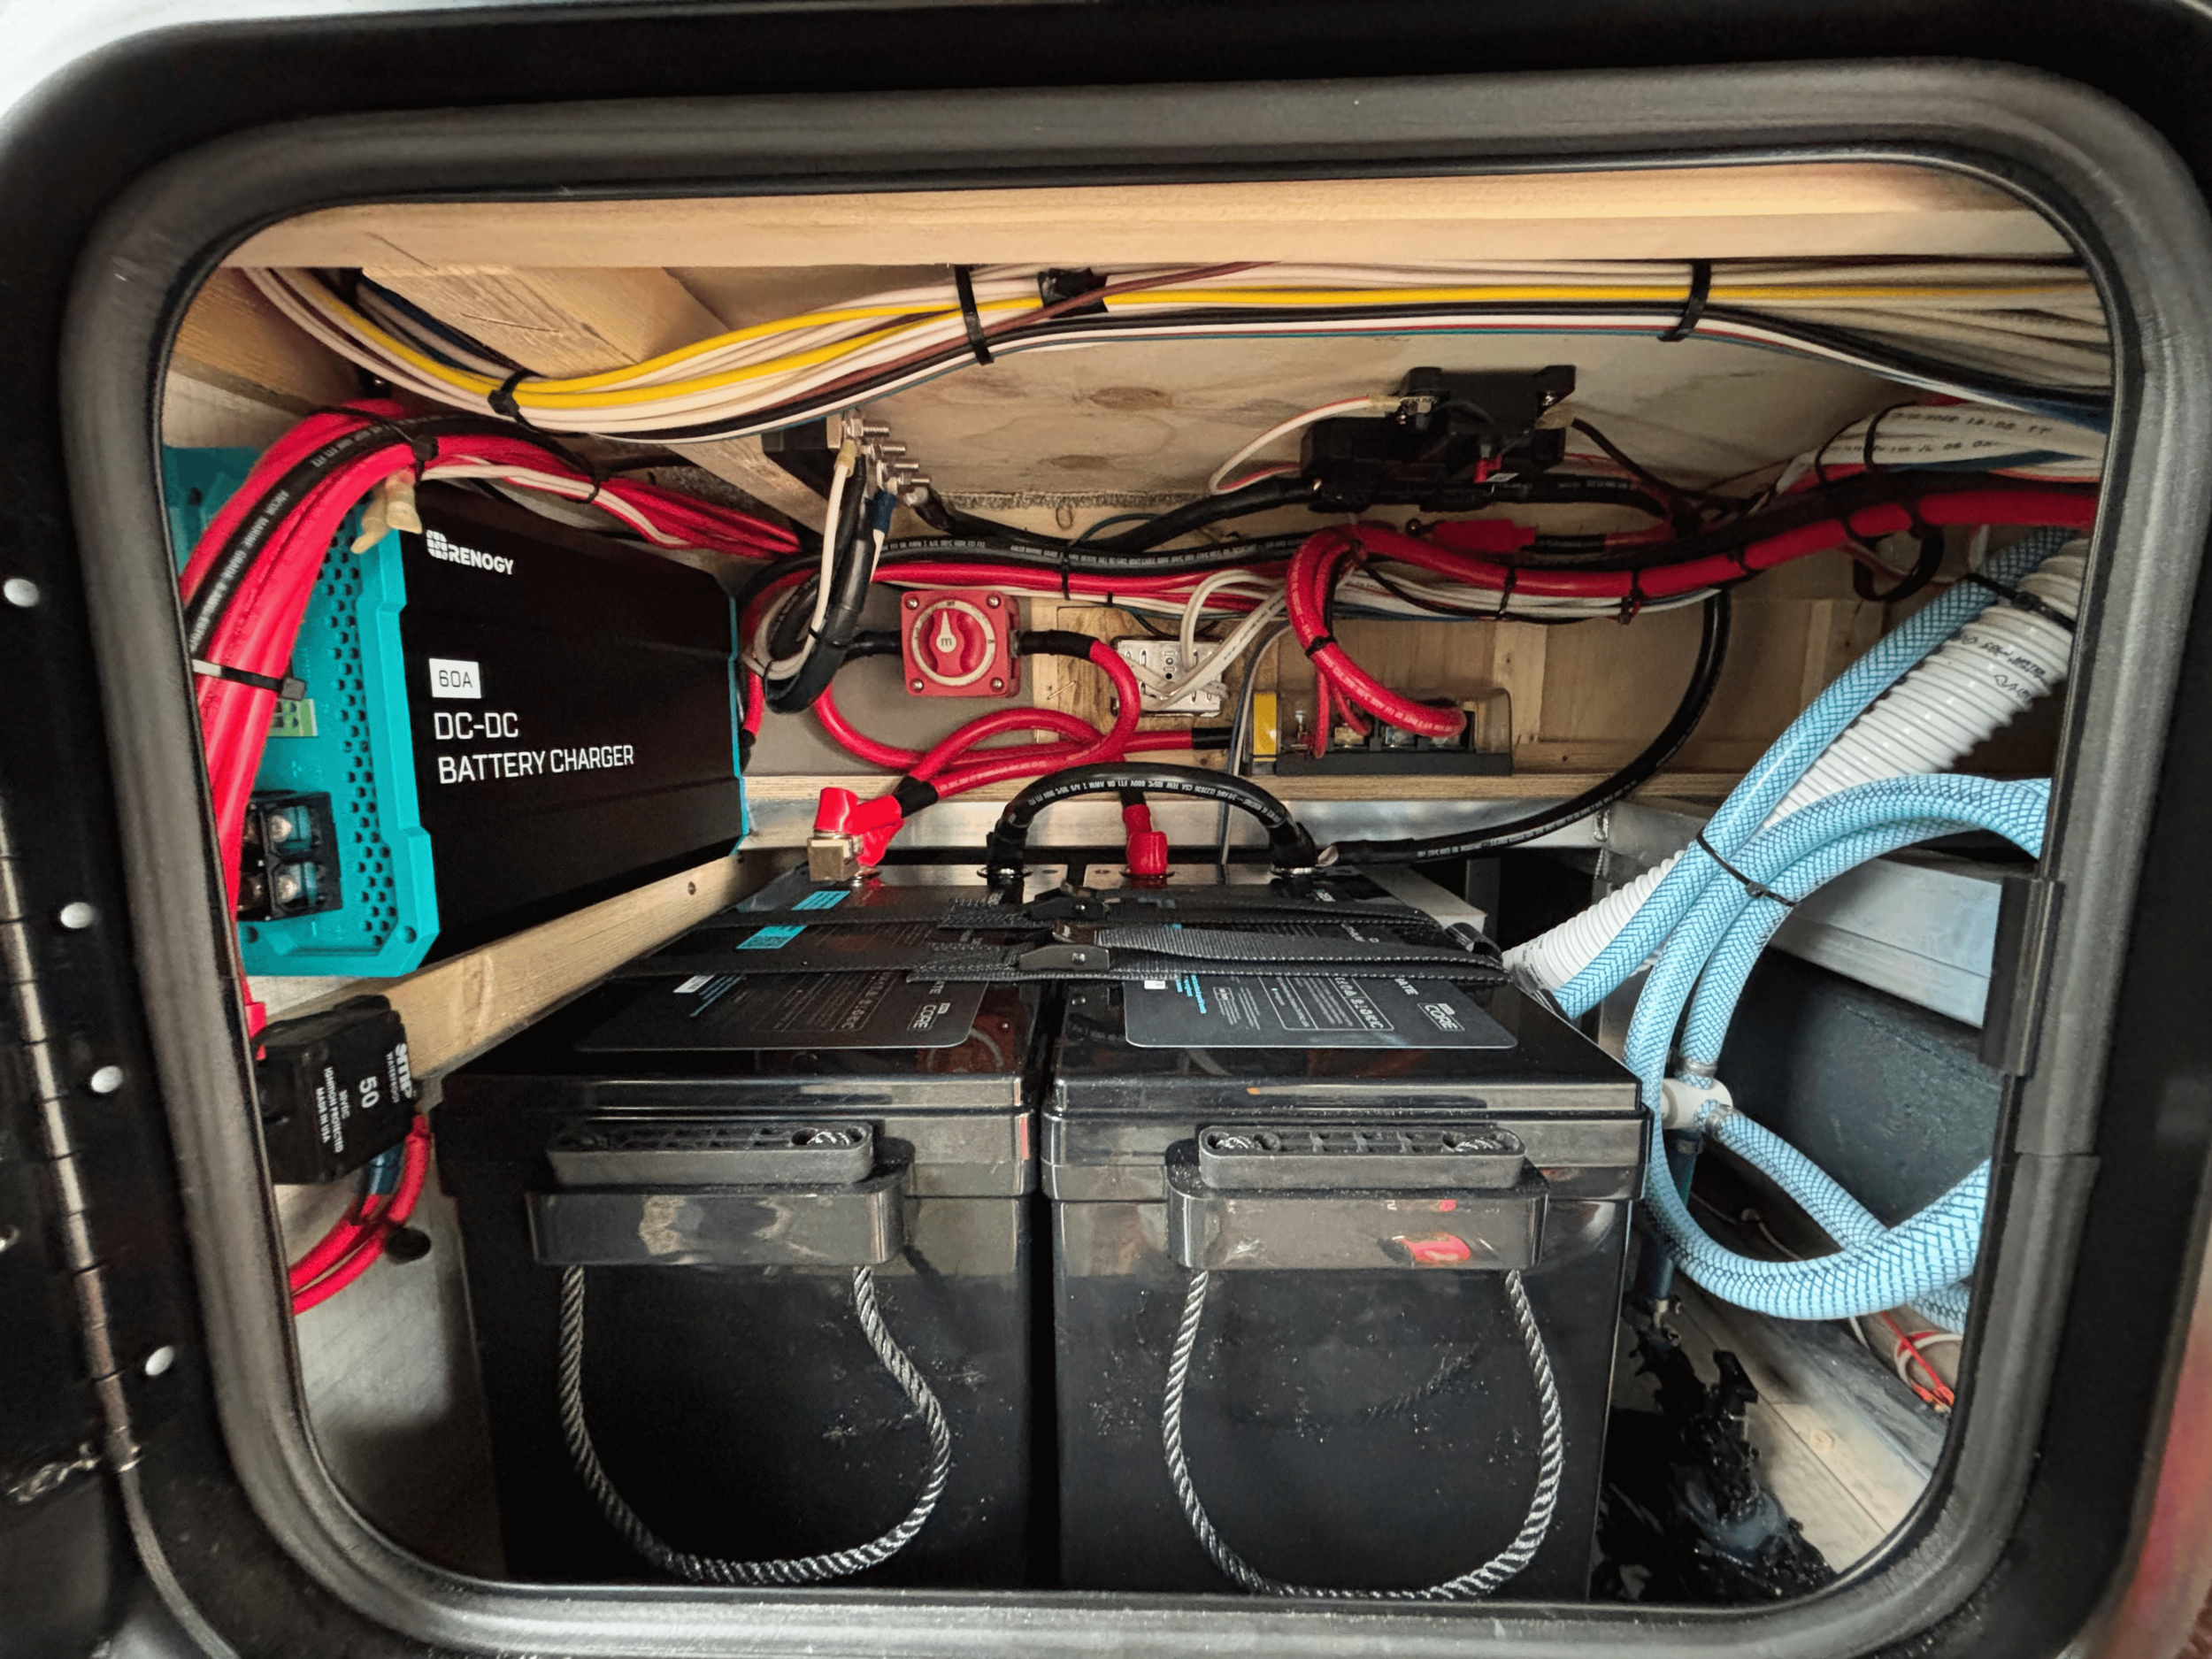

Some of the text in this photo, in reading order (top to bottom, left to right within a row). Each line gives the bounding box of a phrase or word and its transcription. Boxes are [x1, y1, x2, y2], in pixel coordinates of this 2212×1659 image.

[447, 543, 514, 575] RENOGY
[438, 669, 473, 688] 60A
[434, 711, 519, 740] DC-DC
[438, 743, 635, 784] BATTERY CHARGER
[1166, 781, 1179, 790] TEW
[1424, 1004, 1459, 1031] CORE
[315, 1087, 327, 1114] MADE
[359, 1076, 379, 1109] 50
[330, 1107, 344, 1153] PROTECTED
